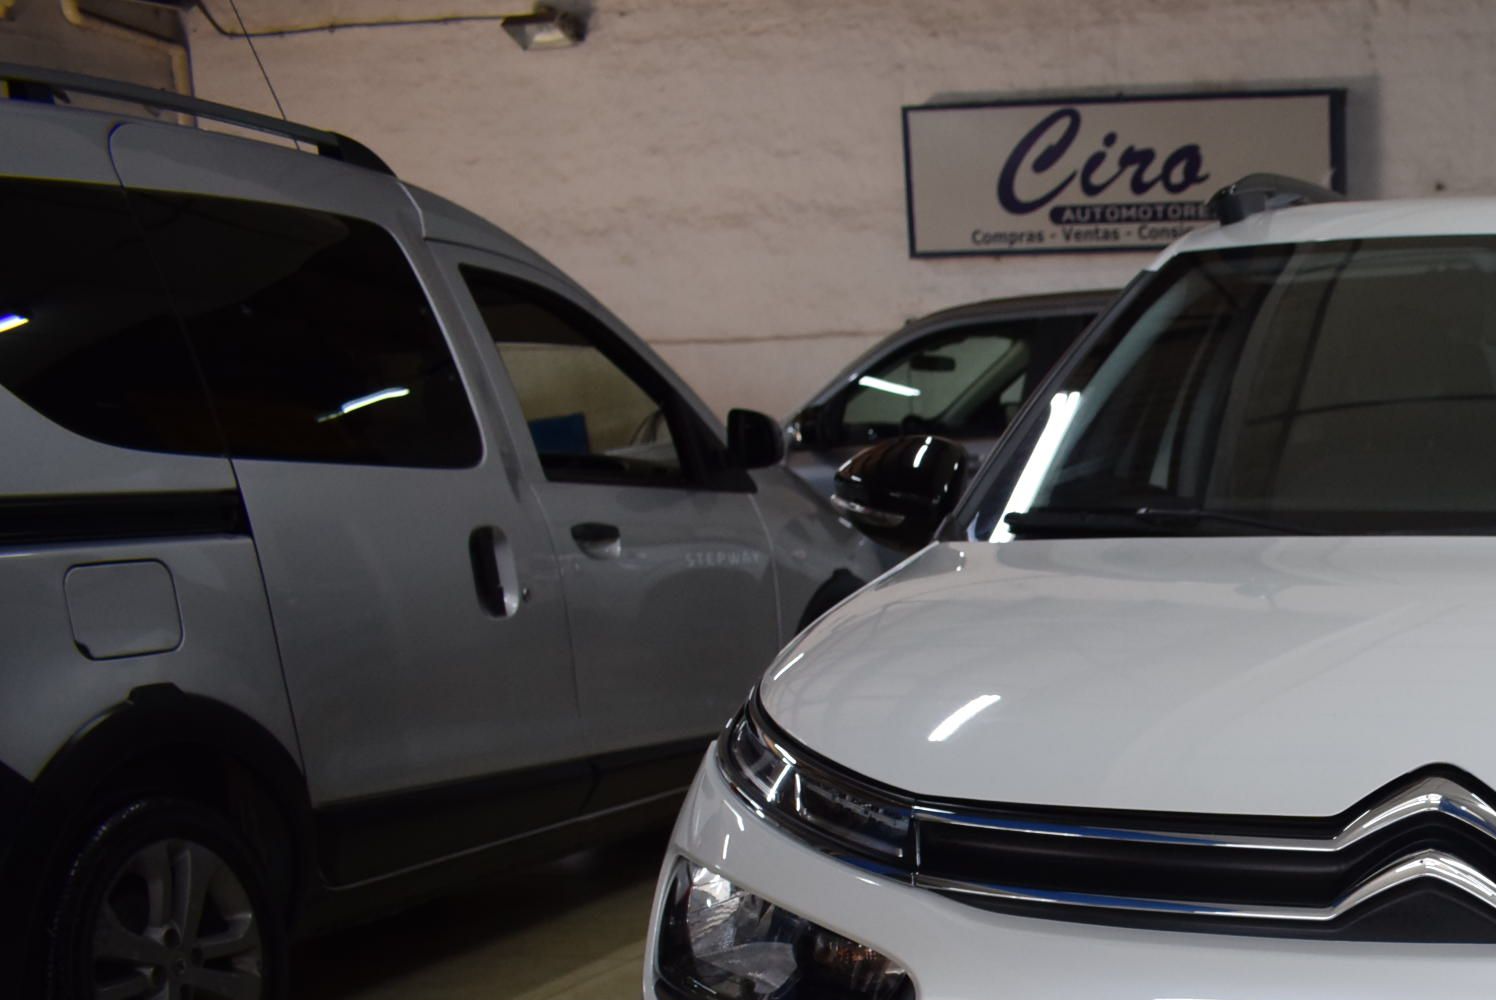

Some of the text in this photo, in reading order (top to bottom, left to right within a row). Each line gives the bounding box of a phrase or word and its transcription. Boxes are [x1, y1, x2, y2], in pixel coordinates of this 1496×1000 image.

[997, 108, 1208, 214] Ciro
[1062, 203, 1213, 221] AUTOMOTORE
[973, 229, 1044, 247] Compras
[1062, 224, 1120, 241] Ventas
